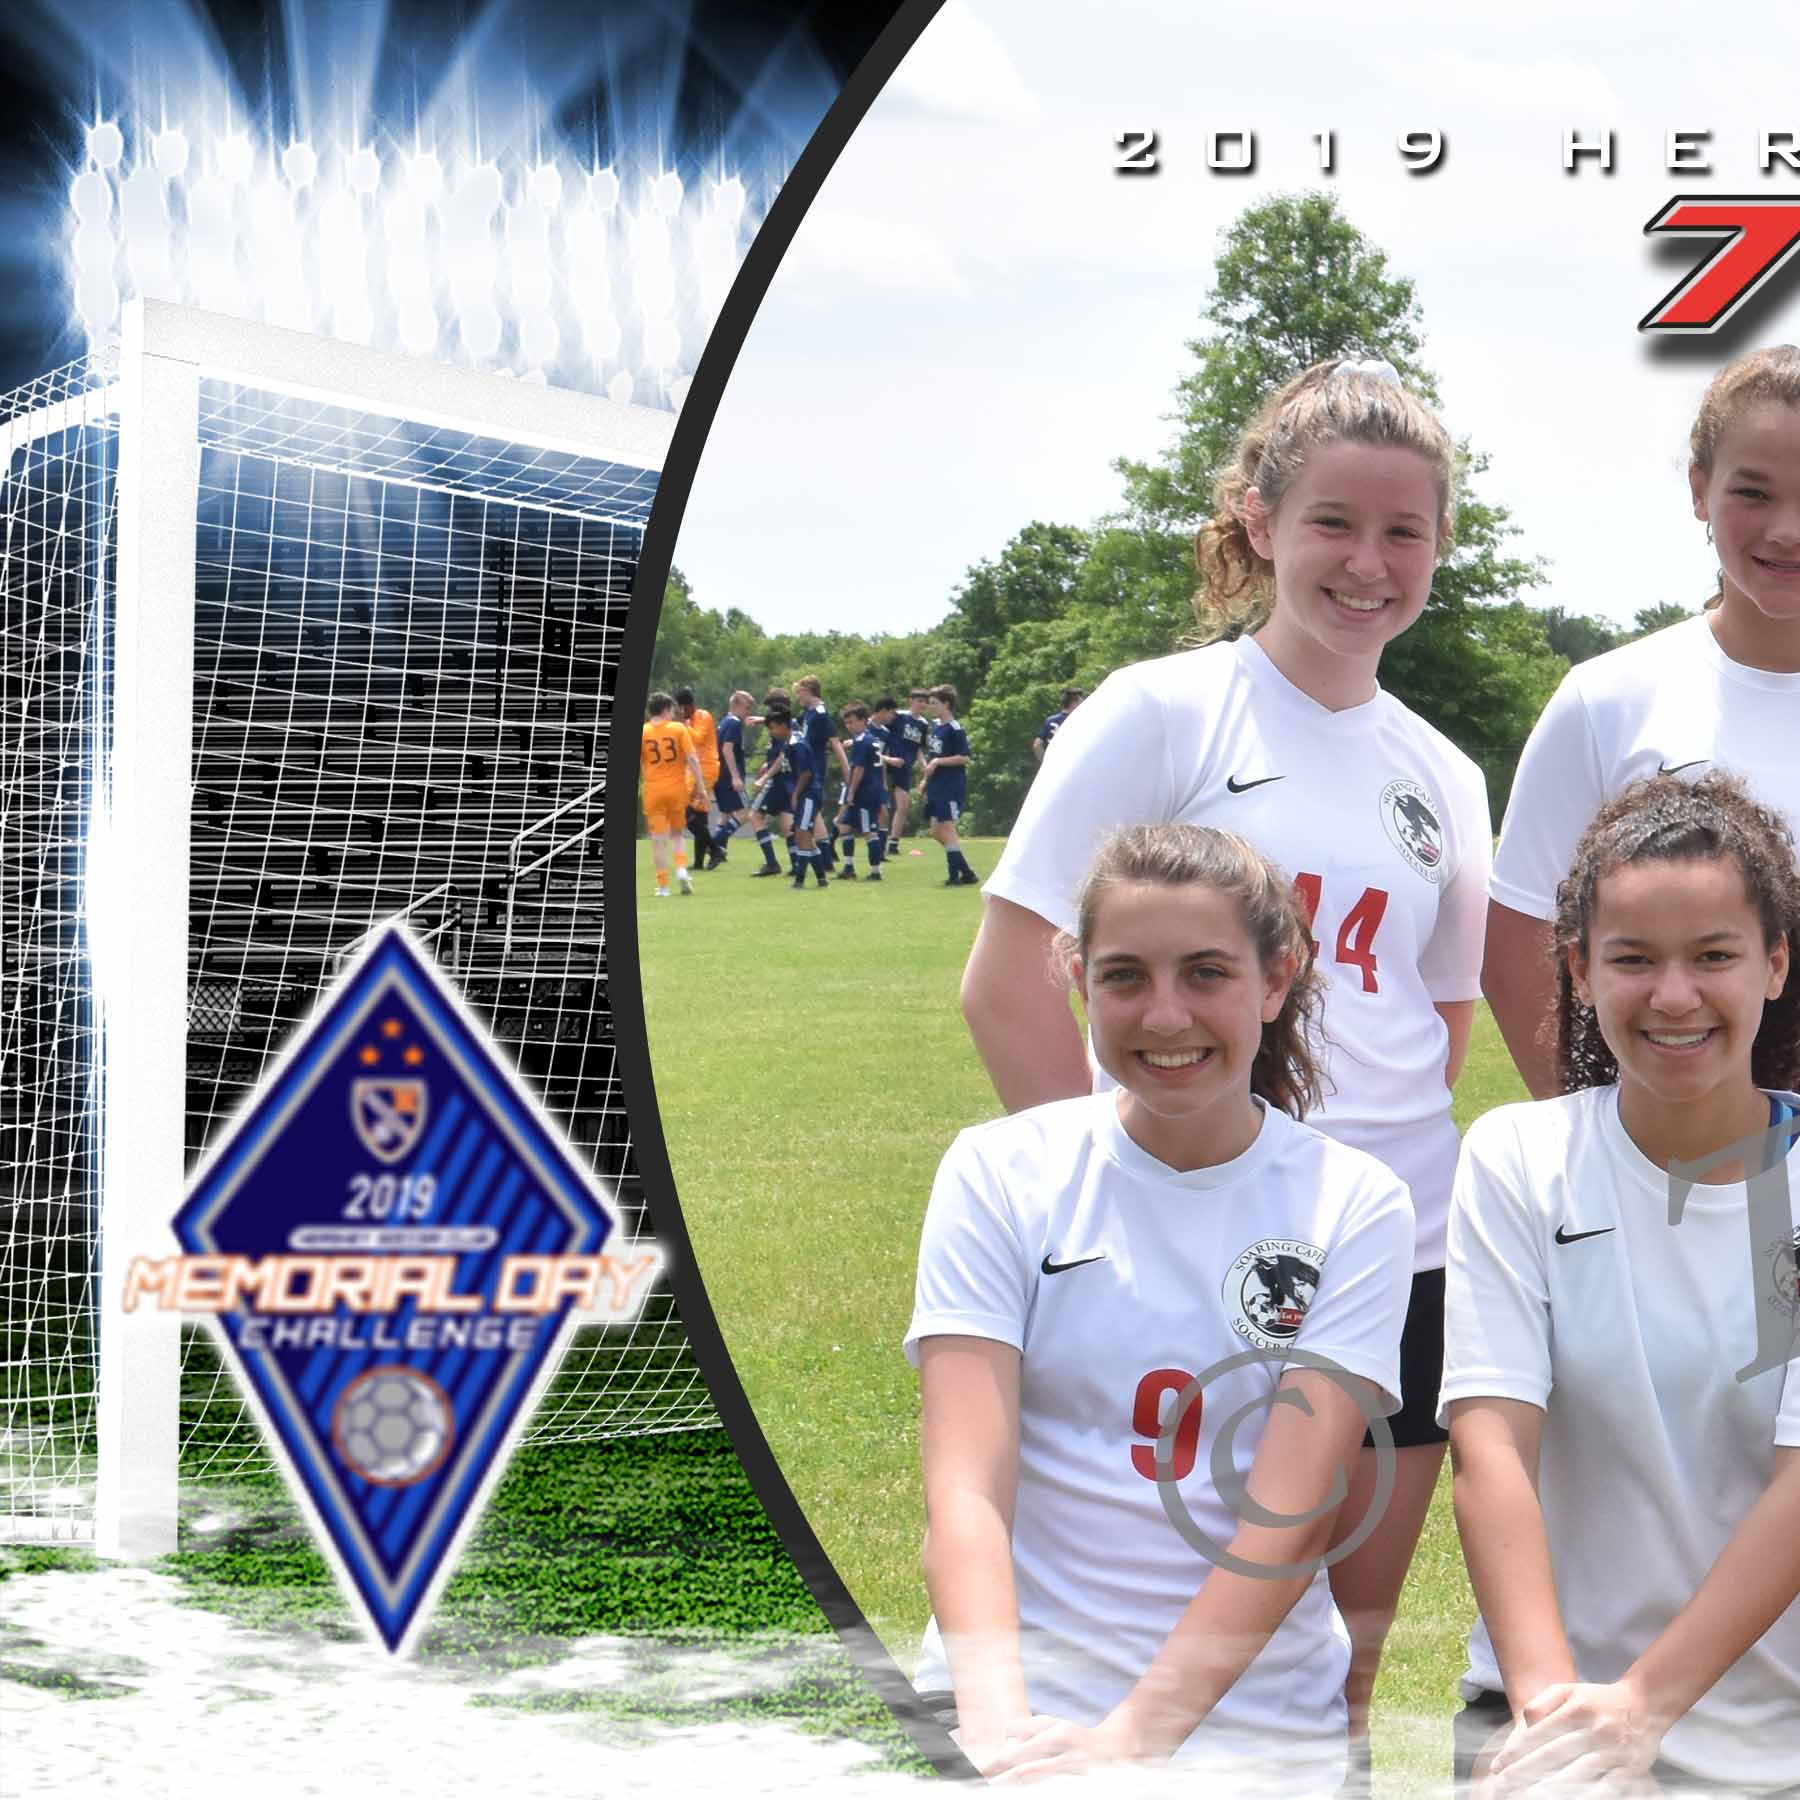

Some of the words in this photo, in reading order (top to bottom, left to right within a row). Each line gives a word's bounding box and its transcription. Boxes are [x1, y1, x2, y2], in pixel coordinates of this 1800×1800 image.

[645, 736, 678, 765] 33
[1235, 1241, 1291, 1272] SOARING
[1233, 1317, 1281, 1353] SOCCER
[1129, 1367, 1204, 1483] 9
